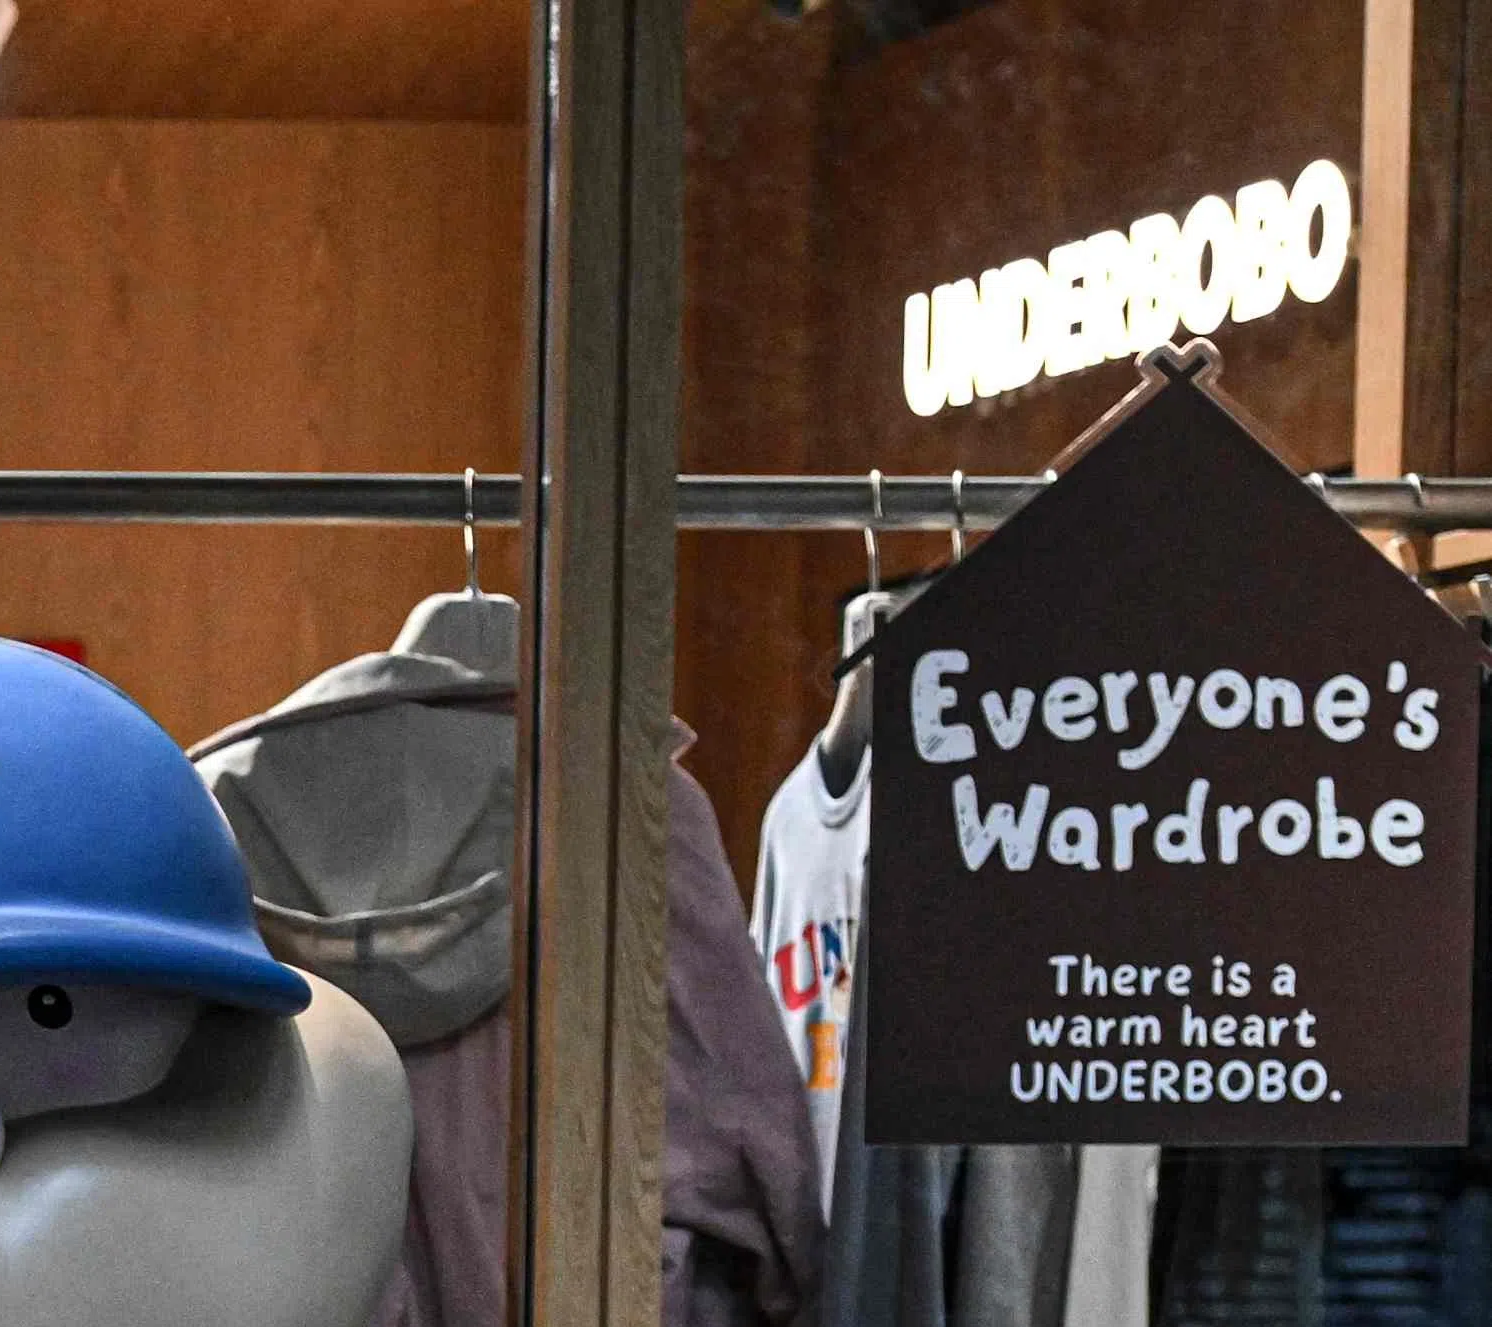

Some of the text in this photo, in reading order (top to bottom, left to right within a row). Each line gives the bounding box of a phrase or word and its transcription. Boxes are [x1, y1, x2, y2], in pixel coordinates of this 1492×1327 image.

[903, 159, 1351, 417] UNDERBOBO
[911, 649, 1440, 771] Everyone's
[953, 774, 1425, 872] Wardrobe
[1048, 955, 1296, 998] There is a
[1026, 1004, 1317, 1048] warm heart
[1010, 1059, 1342, 1103] UNDERBOBO.
